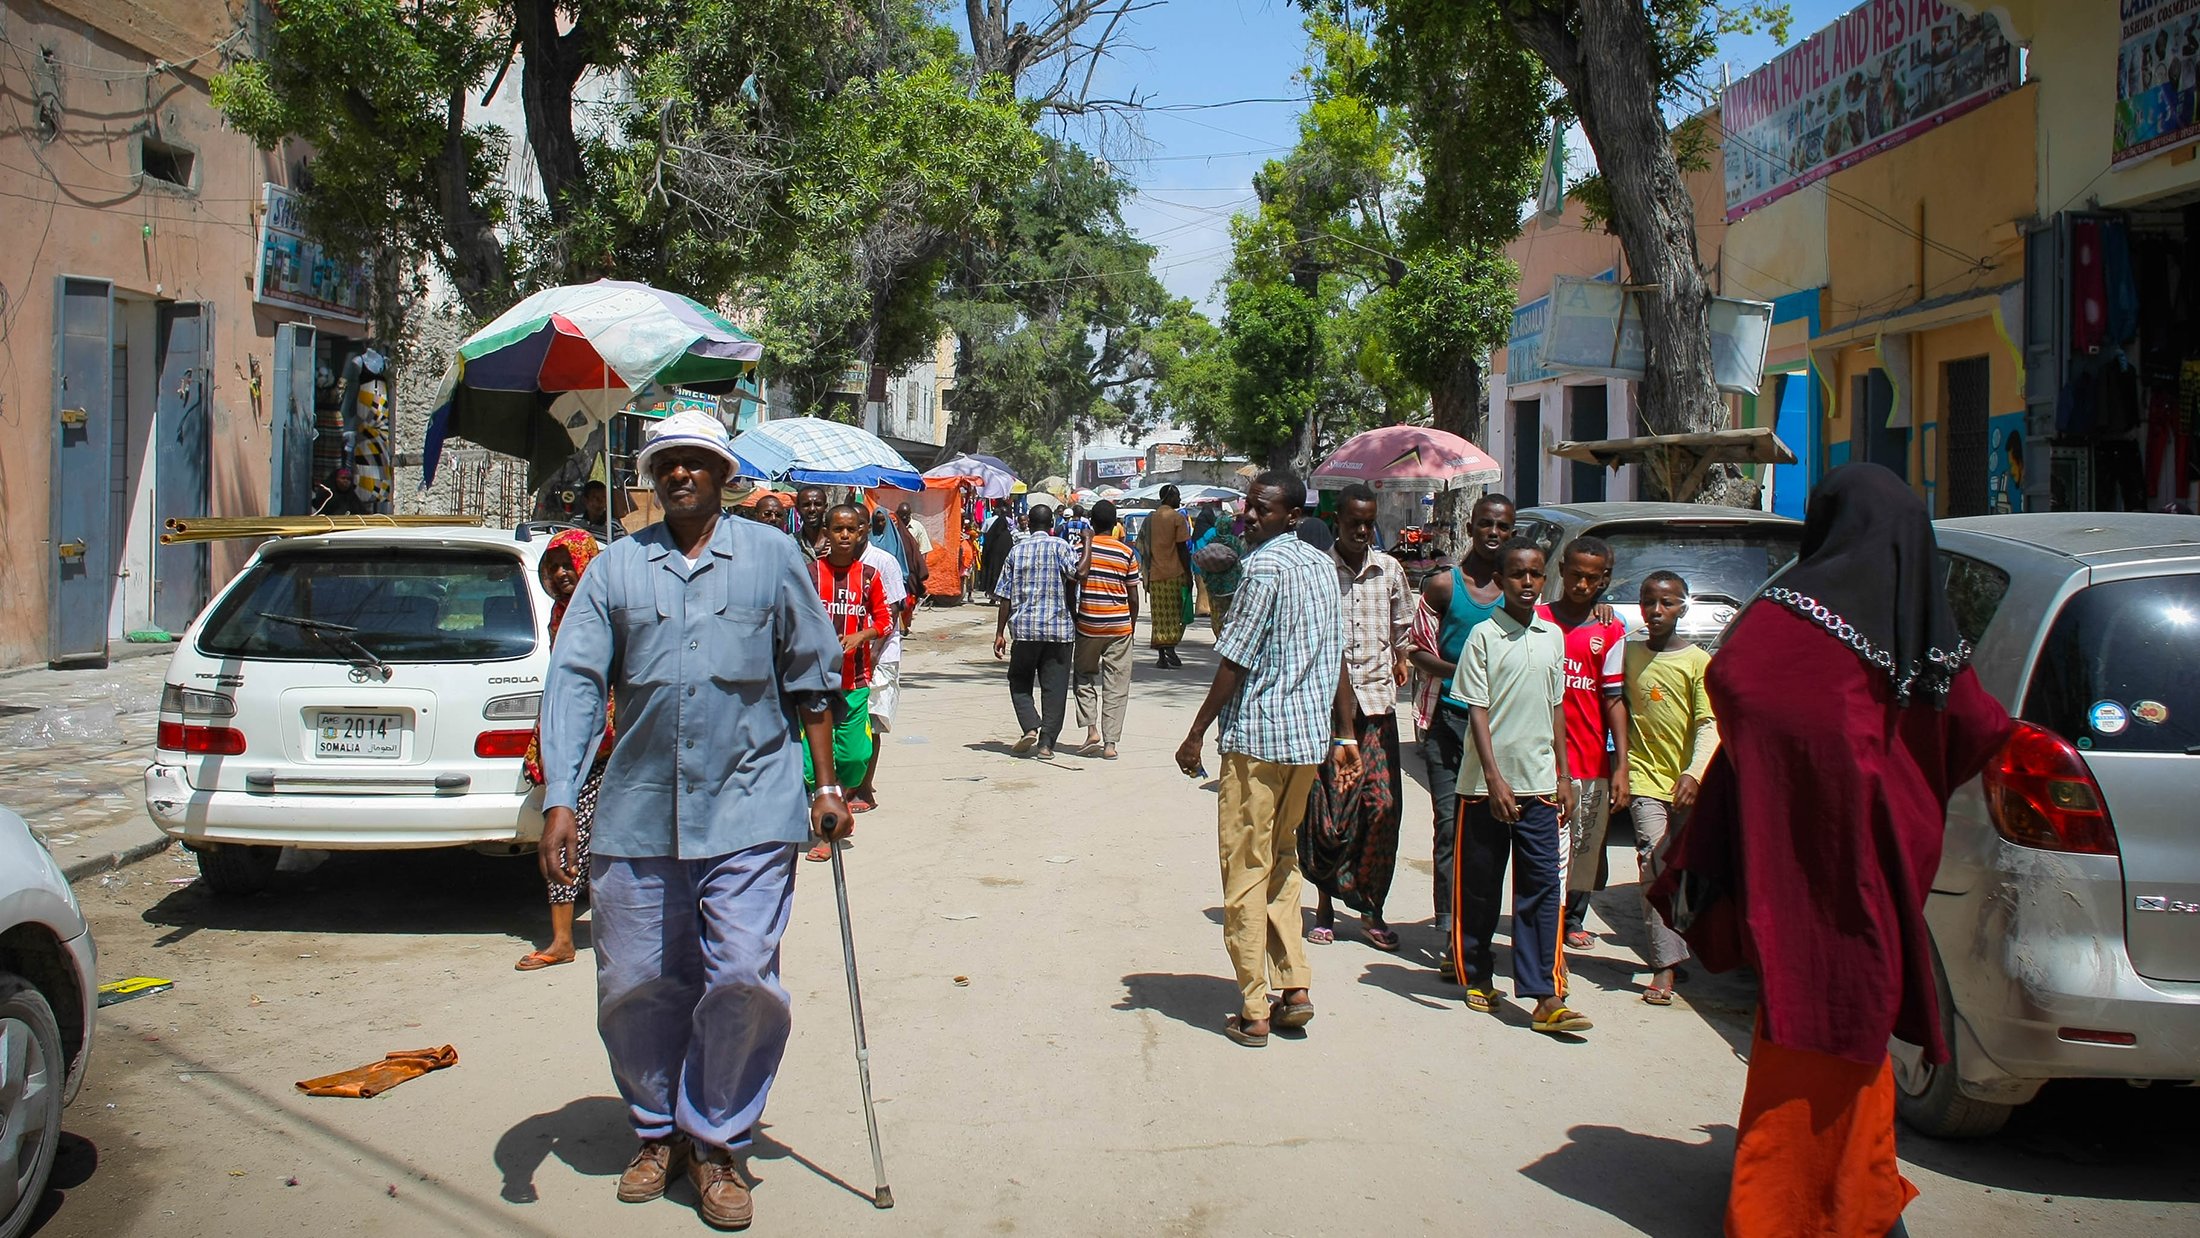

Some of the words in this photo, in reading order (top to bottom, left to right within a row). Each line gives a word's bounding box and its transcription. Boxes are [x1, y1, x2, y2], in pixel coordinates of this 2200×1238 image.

[1782, 33, 1829, 107] HOTEL
[1833, 9, 1869, 78] AND
[838, 588, 857, 602] Fly
[488, 676, 540, 685] COROLLA
[344, 717, 387, 739] 2014
[320, 742, 361, 753] SOMALIA
